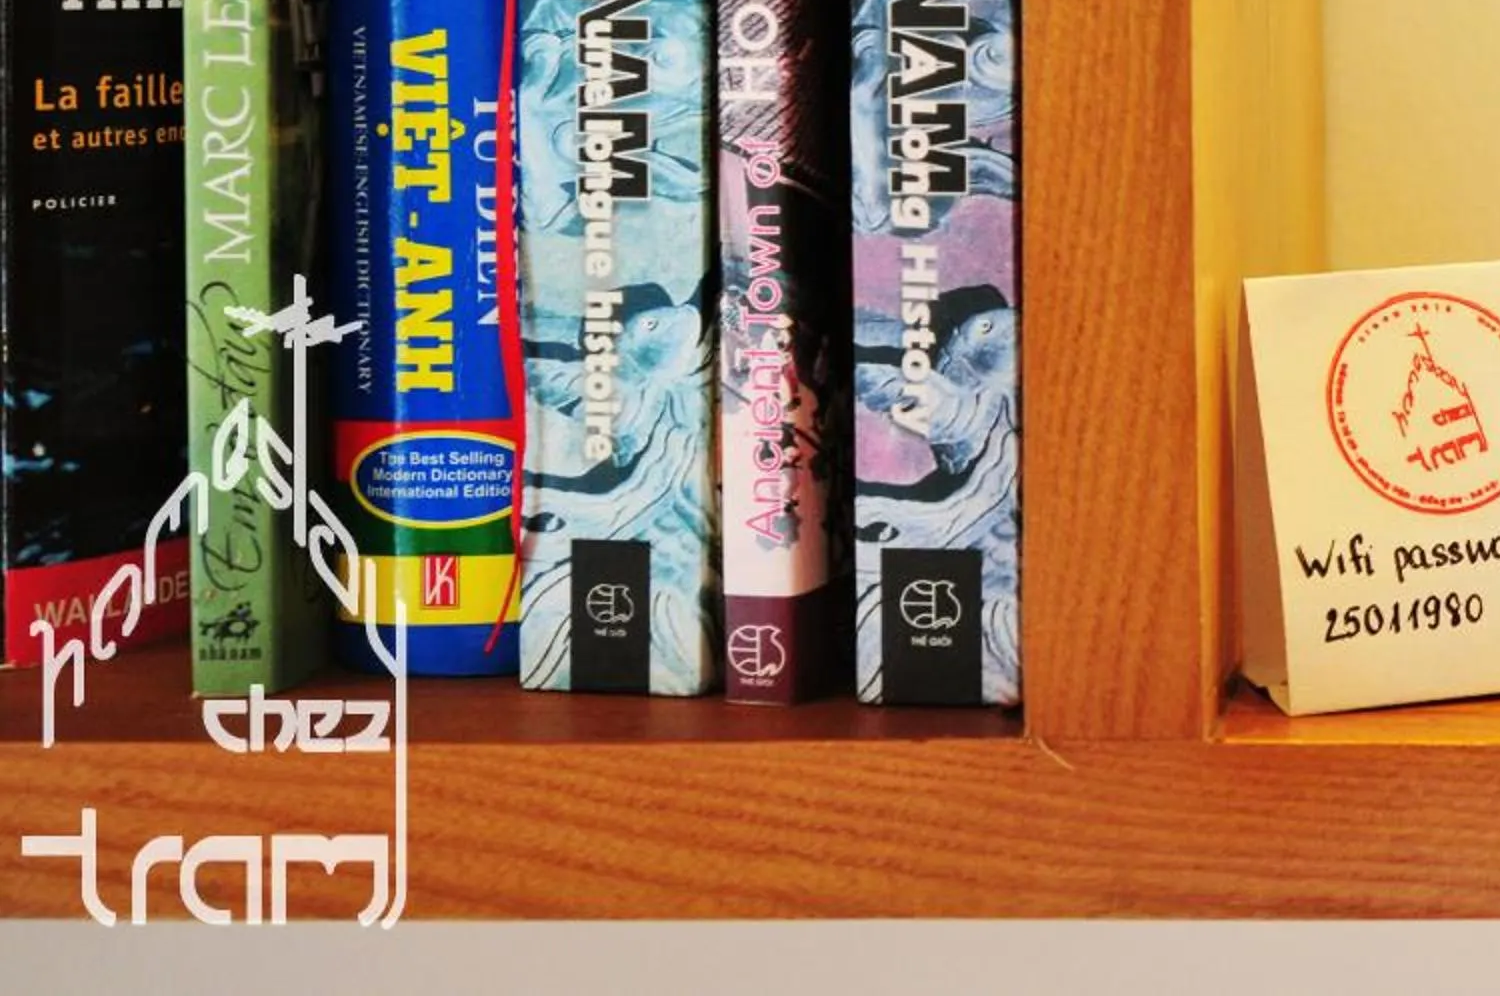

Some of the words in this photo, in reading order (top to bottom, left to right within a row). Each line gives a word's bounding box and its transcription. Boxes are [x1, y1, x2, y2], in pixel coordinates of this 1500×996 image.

[901, 39, 939, 85] A
[35, 78, 78, 110] La
[96, 73, 184, 108] faille
[377, 29, 466, 203] VIỆT
[33, 129, 61, 149] et
[72, 126, 148, 149] autres
[741, 137, 782, 188] of
[201, 85, 257, 264] MARC
[892, 101, 938, 228] Long
[32, 195, 116, 210] POLICIER
[579, 119, 624, 277] longue
[742, 205, 782, 326] Town
[394, 238, 454, 393] ANH
[891, 244, 938, 438] History
[584, 291, 623, 460] histoire
[410, 452, 445, 465] Best
[449, 451, 505, 466] Selling
[744, 348, 784, 542] Ancient
[368, 485, 459, 498] International
[463, 484, 512, 498] Editio
[373, 468, 426, 481] Modern
[431, 468, 513, 483] Dictionary
[1295, 534, 1375, 579] Wifi
[1323, 592, 1484, 643] 25011980
